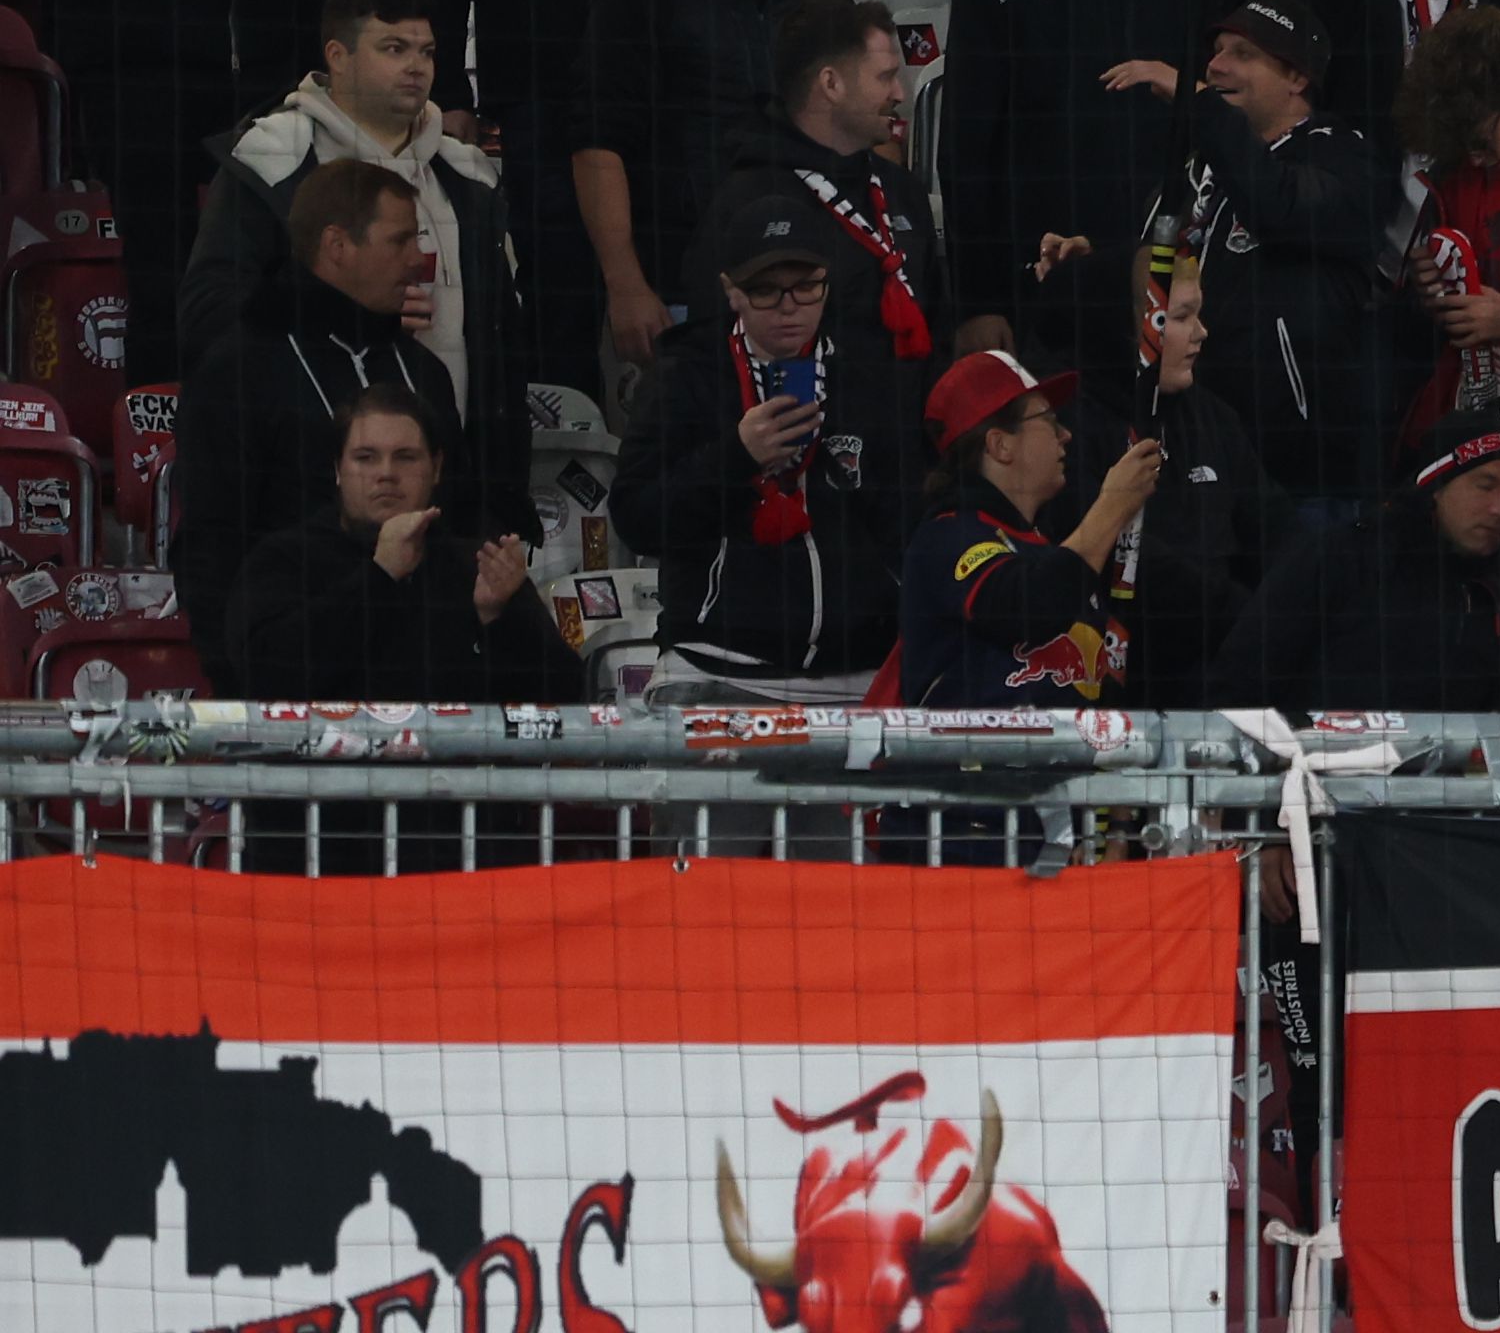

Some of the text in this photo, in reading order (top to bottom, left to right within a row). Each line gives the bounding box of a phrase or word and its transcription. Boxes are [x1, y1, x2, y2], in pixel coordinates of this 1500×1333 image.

[60, 215, 81, 228] 17
[128, 393, 177, 415] FCK
[1268, 960, 1298, 1044] ALPHA
